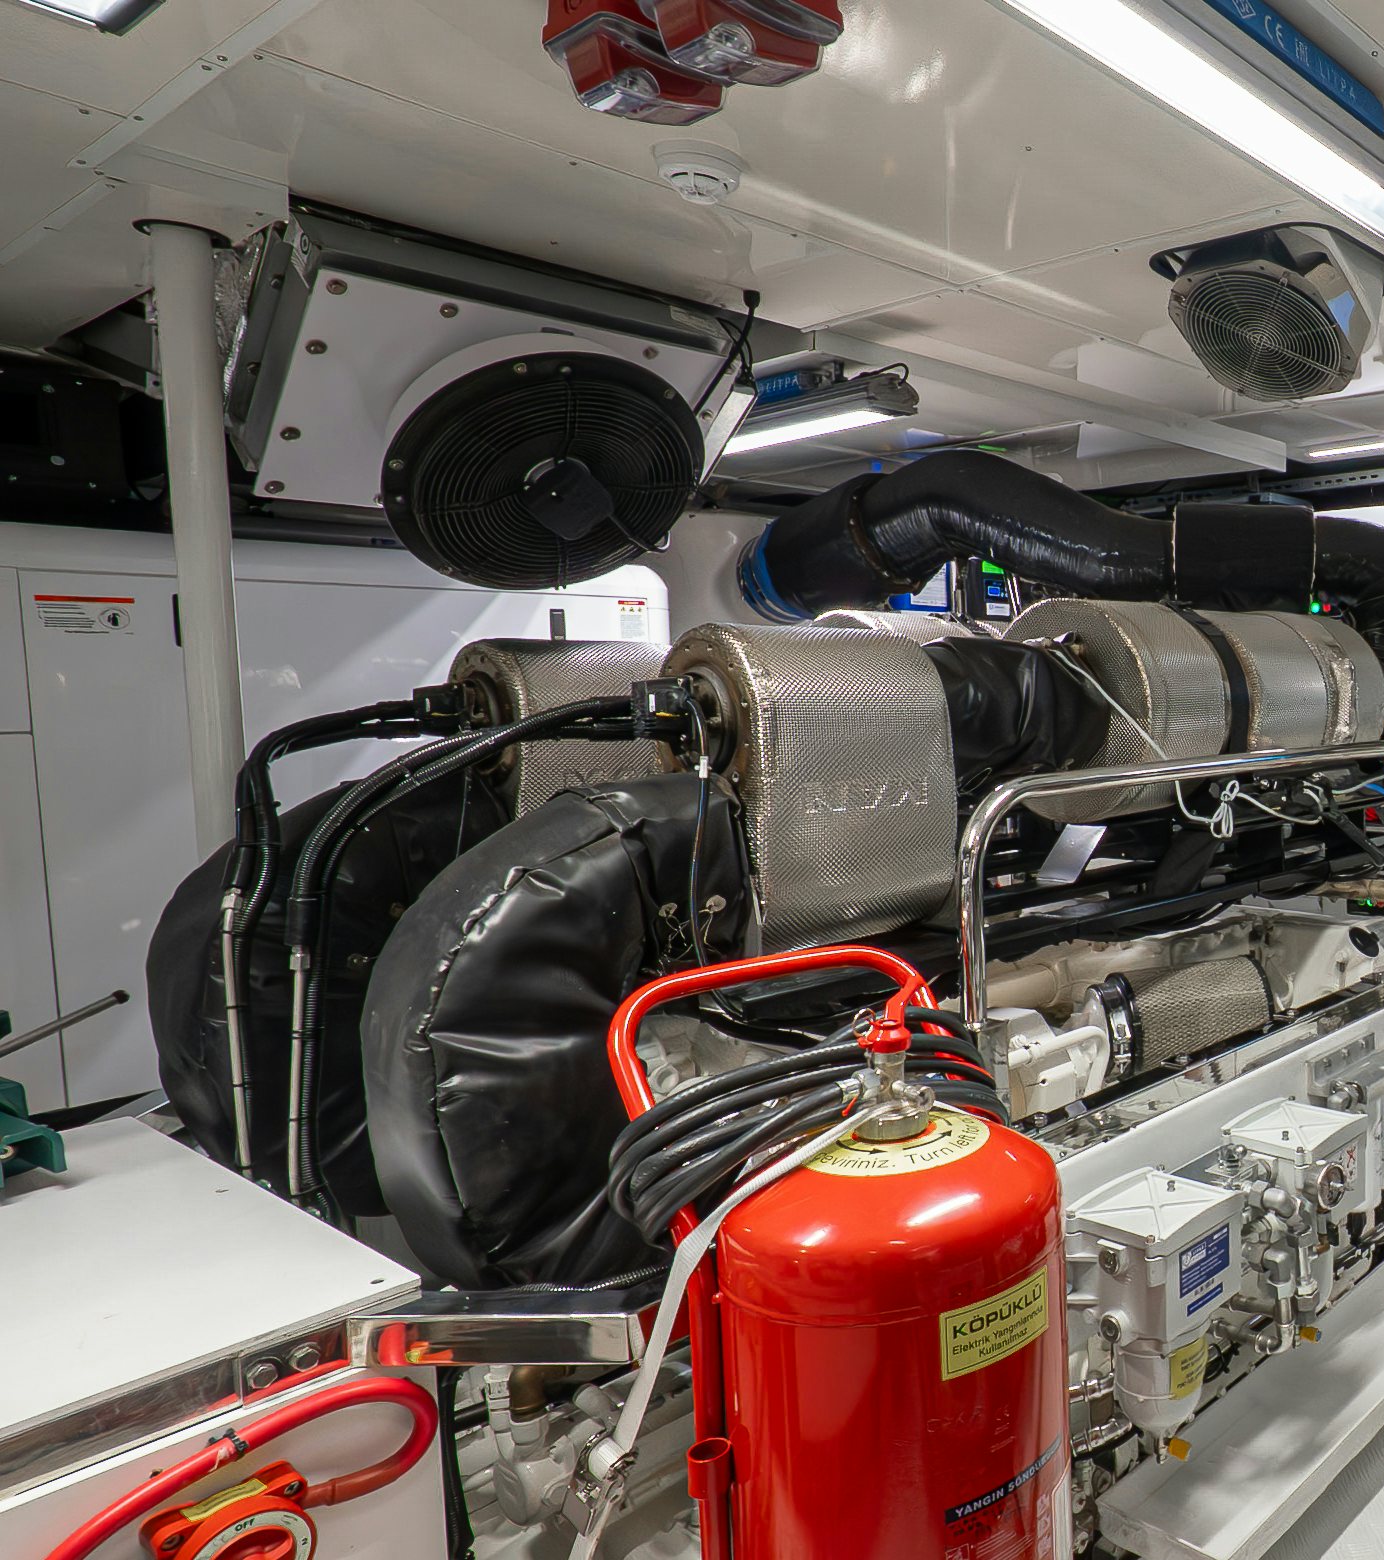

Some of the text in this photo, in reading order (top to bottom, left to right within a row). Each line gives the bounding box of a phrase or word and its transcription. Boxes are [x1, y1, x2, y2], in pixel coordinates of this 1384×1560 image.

[903, 1144, 954, 1165] Turn
[952, 1283, 1042, 1339] KÖPÜKLÜ
[952, 1335, 991, 1355] Elektrik
[978, 1327, 1028, 1358] Kullanılmaz
[955, 1489, 1005, 1518] YANGIN
[234, 1517, 257, 1532] OFF
